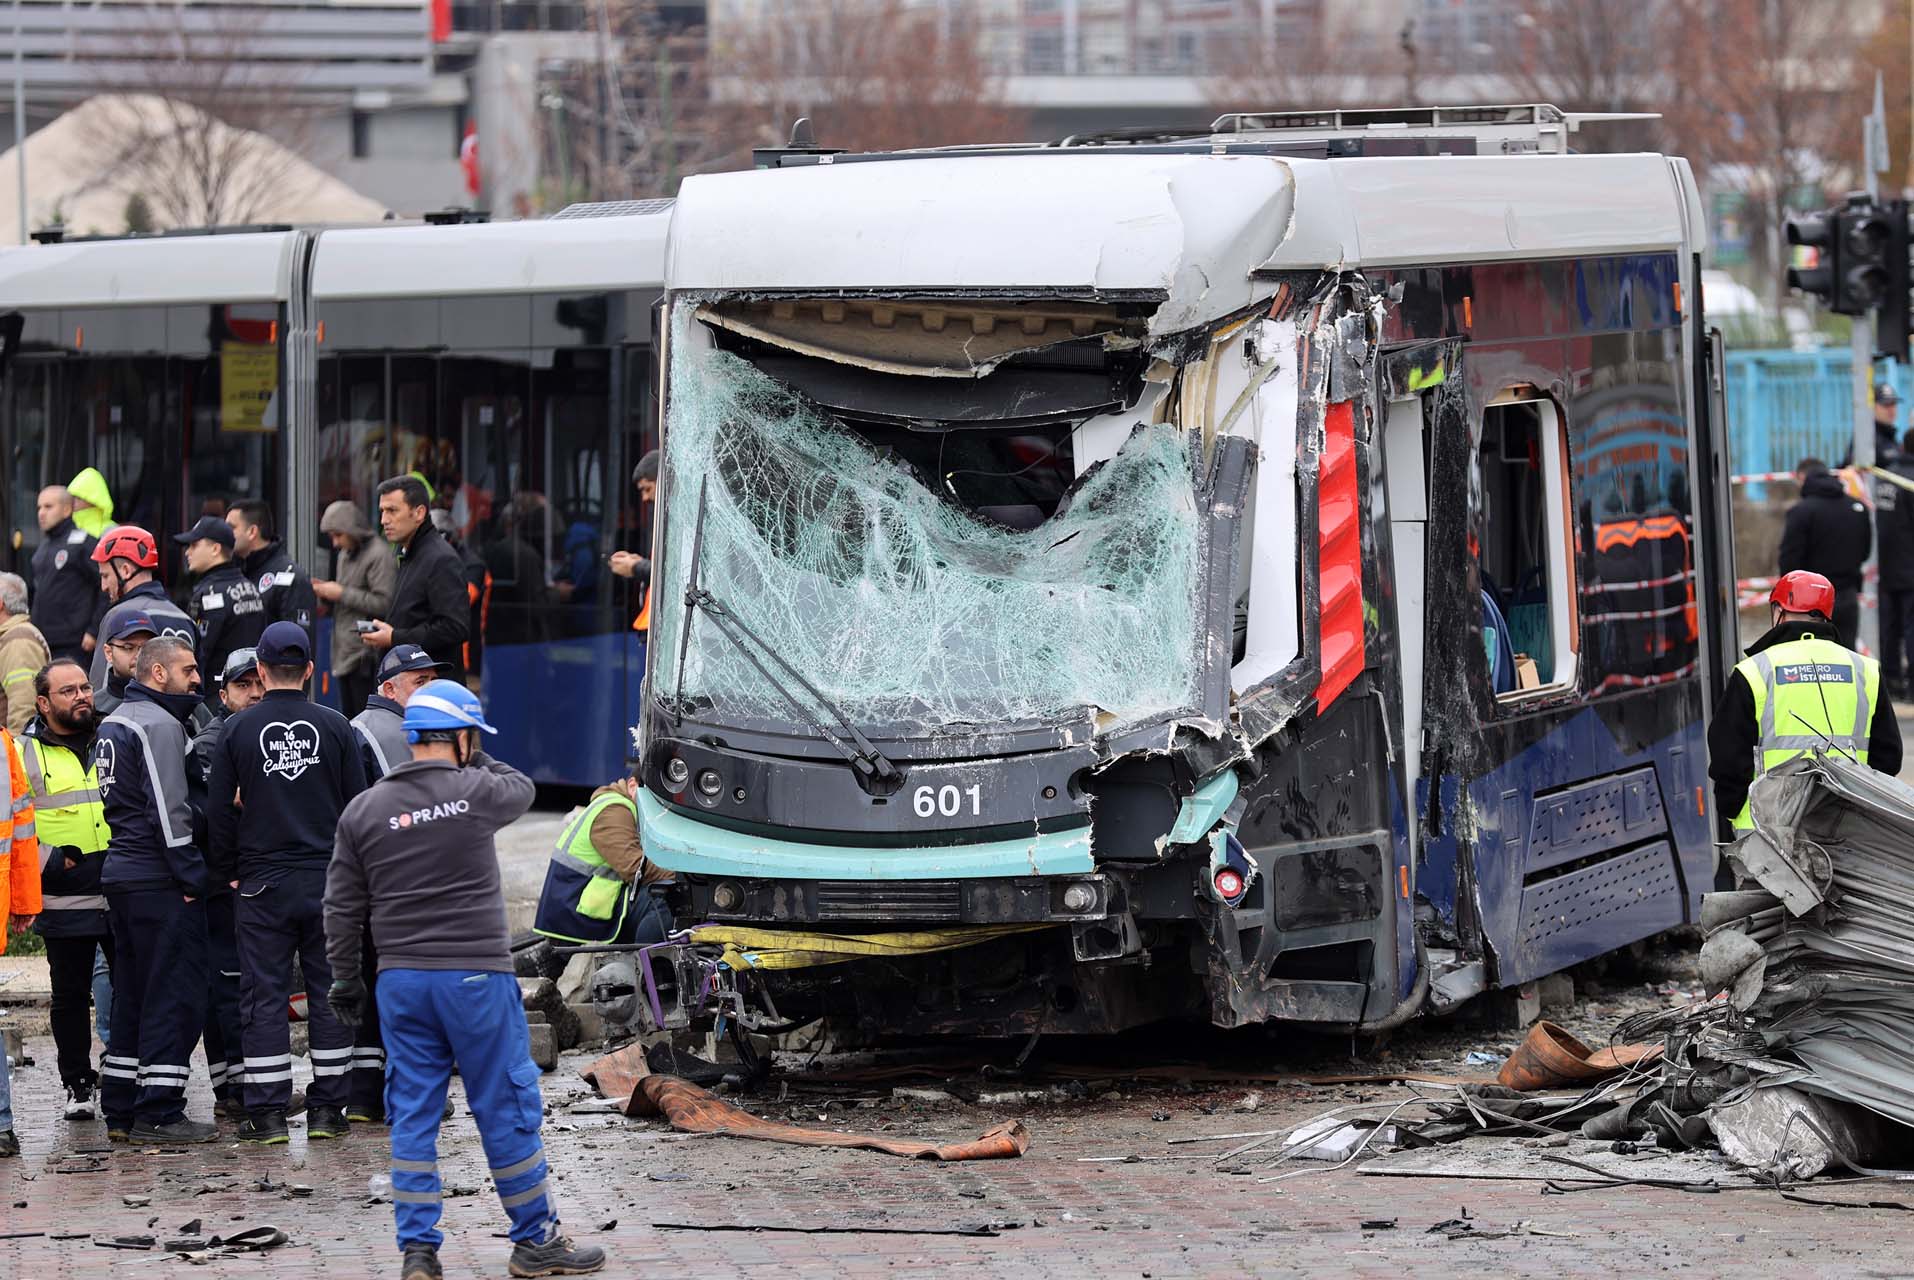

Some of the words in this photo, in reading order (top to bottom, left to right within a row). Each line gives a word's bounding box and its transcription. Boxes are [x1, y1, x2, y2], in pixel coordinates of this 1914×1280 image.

[1799, 665, 1831, 673] METRO
[283, 730, 295, 741] 16
[913, 784, 980, 818] 601
[389, 800, 469, 830] SOPRANO
